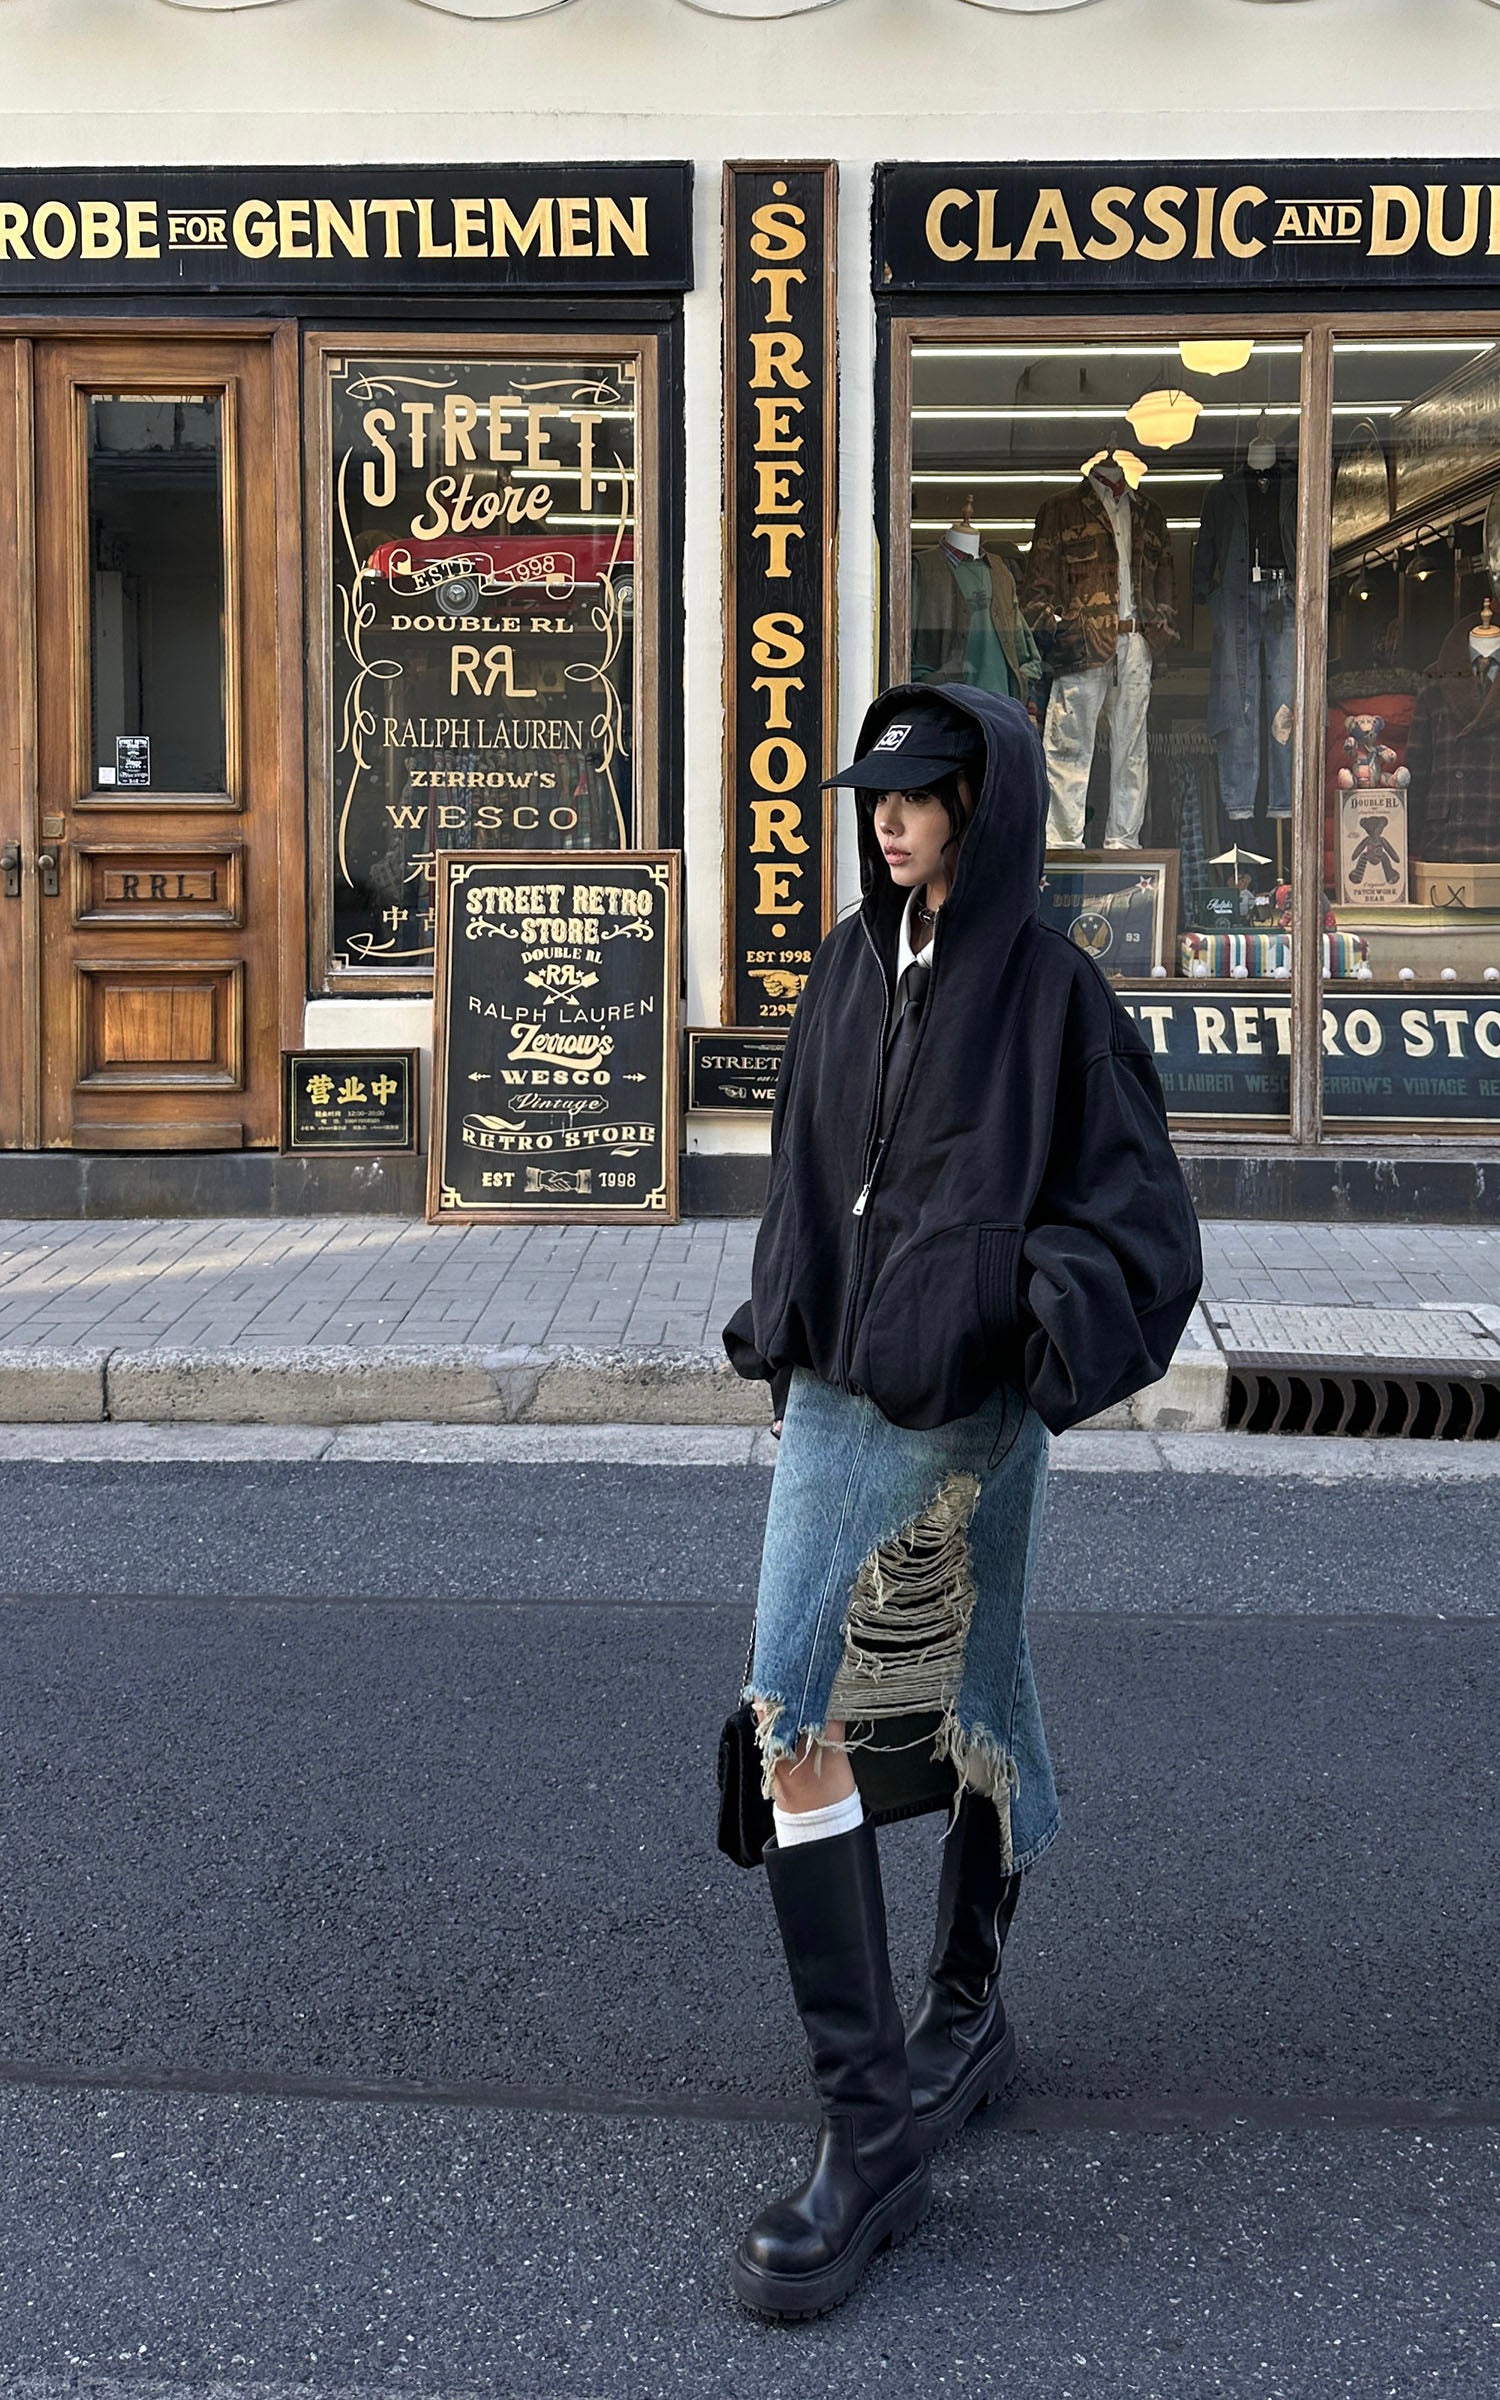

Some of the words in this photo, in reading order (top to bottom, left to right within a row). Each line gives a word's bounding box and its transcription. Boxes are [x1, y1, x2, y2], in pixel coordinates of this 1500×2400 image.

[0, 201, 160, 260] ROBE
[169, 216, 226, 243] FOR
[233, 196, 649, 259] GENTLEMEN
[925, 185, 1269, 261] CLASSIC
[1274, 204, 1363, 237] AND
[749, 202, 812, 578] STREET
[411, 473, 554, 541] Store
[504, 554, 557, 586] 1998
[391, 614, 522, 633] DOUBLE
[529, 617, 574, 634] RL
[382, 717, 470, 749] RALPH
[476, 719, 585, 751] LAUREN
[749, 612, 811, 916] STORE
[409, 770, 557, 790] ZERROW'S
[385, 804, 579, 831] WESCO
[1351, 798, 1385, 809] DOUBLE
[1385, 798, 1400, 808] RL
[121, 873, 195, 901] RRL
[466, 885, 566, 915] STREET
[572, 885, 654, 917] RETRO
[520, 917, 600, 945] STORE
[521, 947, 582, 965] DOUBLE
[585, 950, 603, 965] RL
[746, 951, 777, 963] EST
[780, 950, 812, 963] 1998
[468, 995, 547, 1023] RALPH
[559, 995, 655, 1024] LAUREN
[1401, 1009, 1500, 1059] STO
[701, 1055, 782, 1070] STREET
[305, 1073, 398, 1106] 营业中
[500, 1069, 612, 1086] WESCO
[515, 1092, 603, 1115] Vintage
[462, 1126, 554, 1151] RETRO
[563, 1125, 656, 1148] STORE
[481, 1172, 516, 1188] EST
[598, 1172, 637, 1188] 1998
